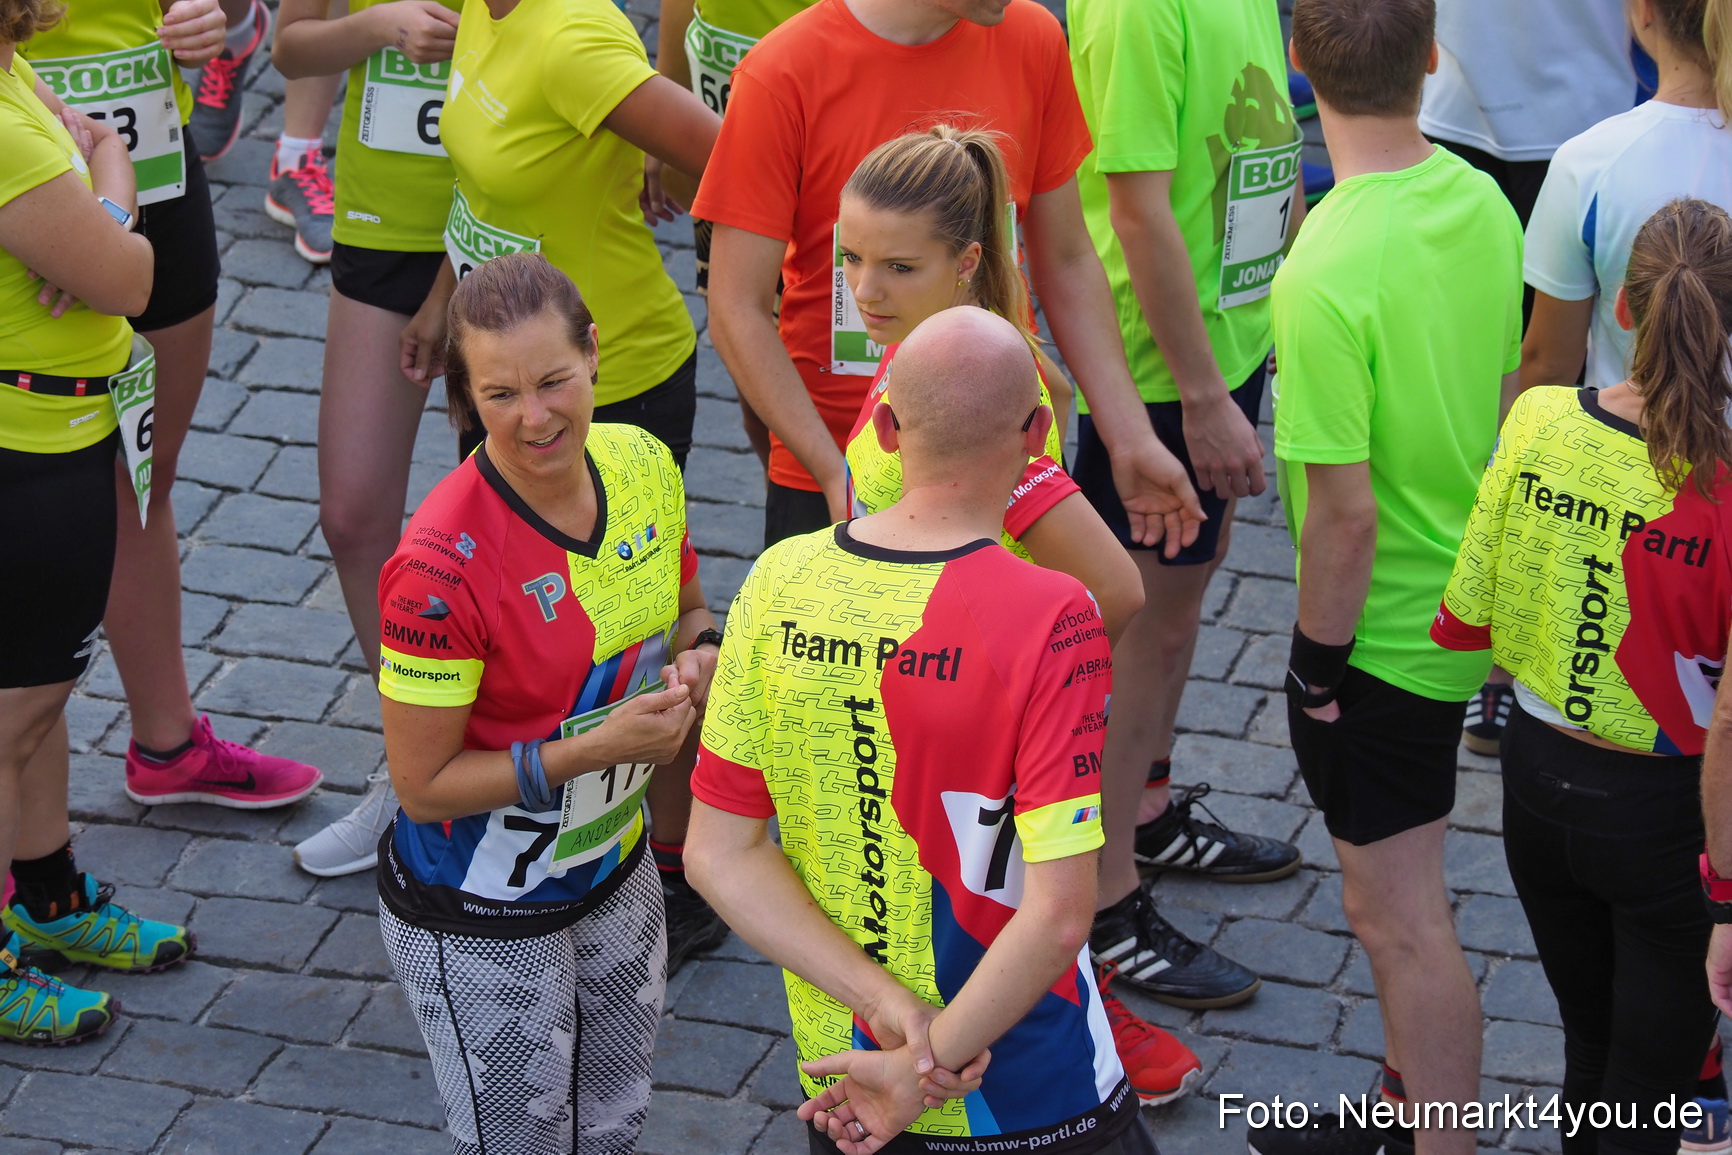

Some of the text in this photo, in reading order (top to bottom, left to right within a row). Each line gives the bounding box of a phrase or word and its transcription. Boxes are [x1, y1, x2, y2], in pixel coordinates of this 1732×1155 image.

[38, 52, 160, 94] BOCK
[384, 48, 450, 80] BO
[1243, 150, 1300, 190] BOC
[347, 211, 381, 223] SPIRO
[118, 364, 155, 401] BO
[138, 463, 151, 491] JU
[416, 526, 455, 544] zerbock
[1519, 472, 1712, 568] Team Partl
[411, 537, 467, 568] medienwerk
[407, 558, 462, 586] ABRAHAM
[396, 602, 414, 614] YEARS
[398, 595, 423, 609] THE NEXT
[384, 619, 453, 650] BMW M.
[1051, 626, 1107, 653] medienwe
[1565, 554, 1614, 724] orsport
[781, 620, 963, 682] Team Partl
[393, 662, 461, 682] Motorsport
[1071, 722, 1104, 737] 100 YEAR
[1082, 711, 1105, 724] THE NE
[1073, 749, 1103, 777] BM
[571, 806, 630, 851] ANDREA
[844, 695, 888, 965] Motorsport
[978, 795, 1018, 892] 7
[504, 814, 560, 888] 7
[1110, 1080, 1131, 1112] www.
[926, 1117, 1097, 1153] www.bmw-partl.de
